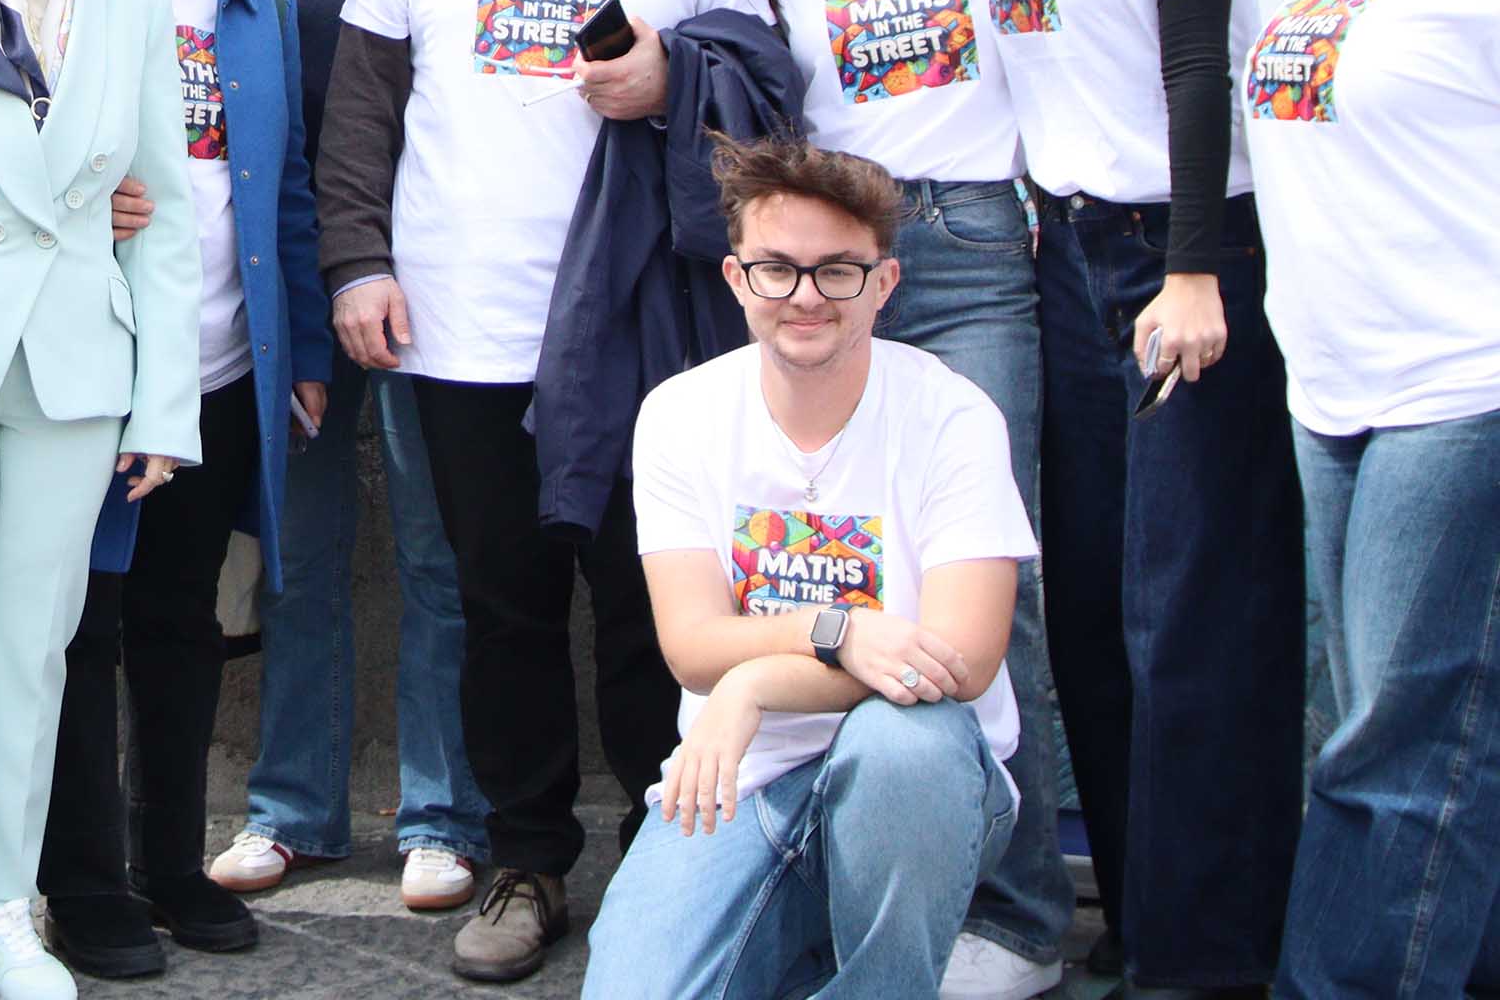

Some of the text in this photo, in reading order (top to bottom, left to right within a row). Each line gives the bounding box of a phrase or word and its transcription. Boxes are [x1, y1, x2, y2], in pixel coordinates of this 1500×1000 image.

[523, 1, 572, 20] IN THE
[872, 14, 924, 37] IN THE
[850, 29, 944, 68] STREET
[1255, 53, 1316, 82] STREET
[180, 83, 207, 100] THE
[184, 102, 222, 125] EET
[757, 548, 864, 586] MATHS
[779, 578, 834, 603] IN THE
